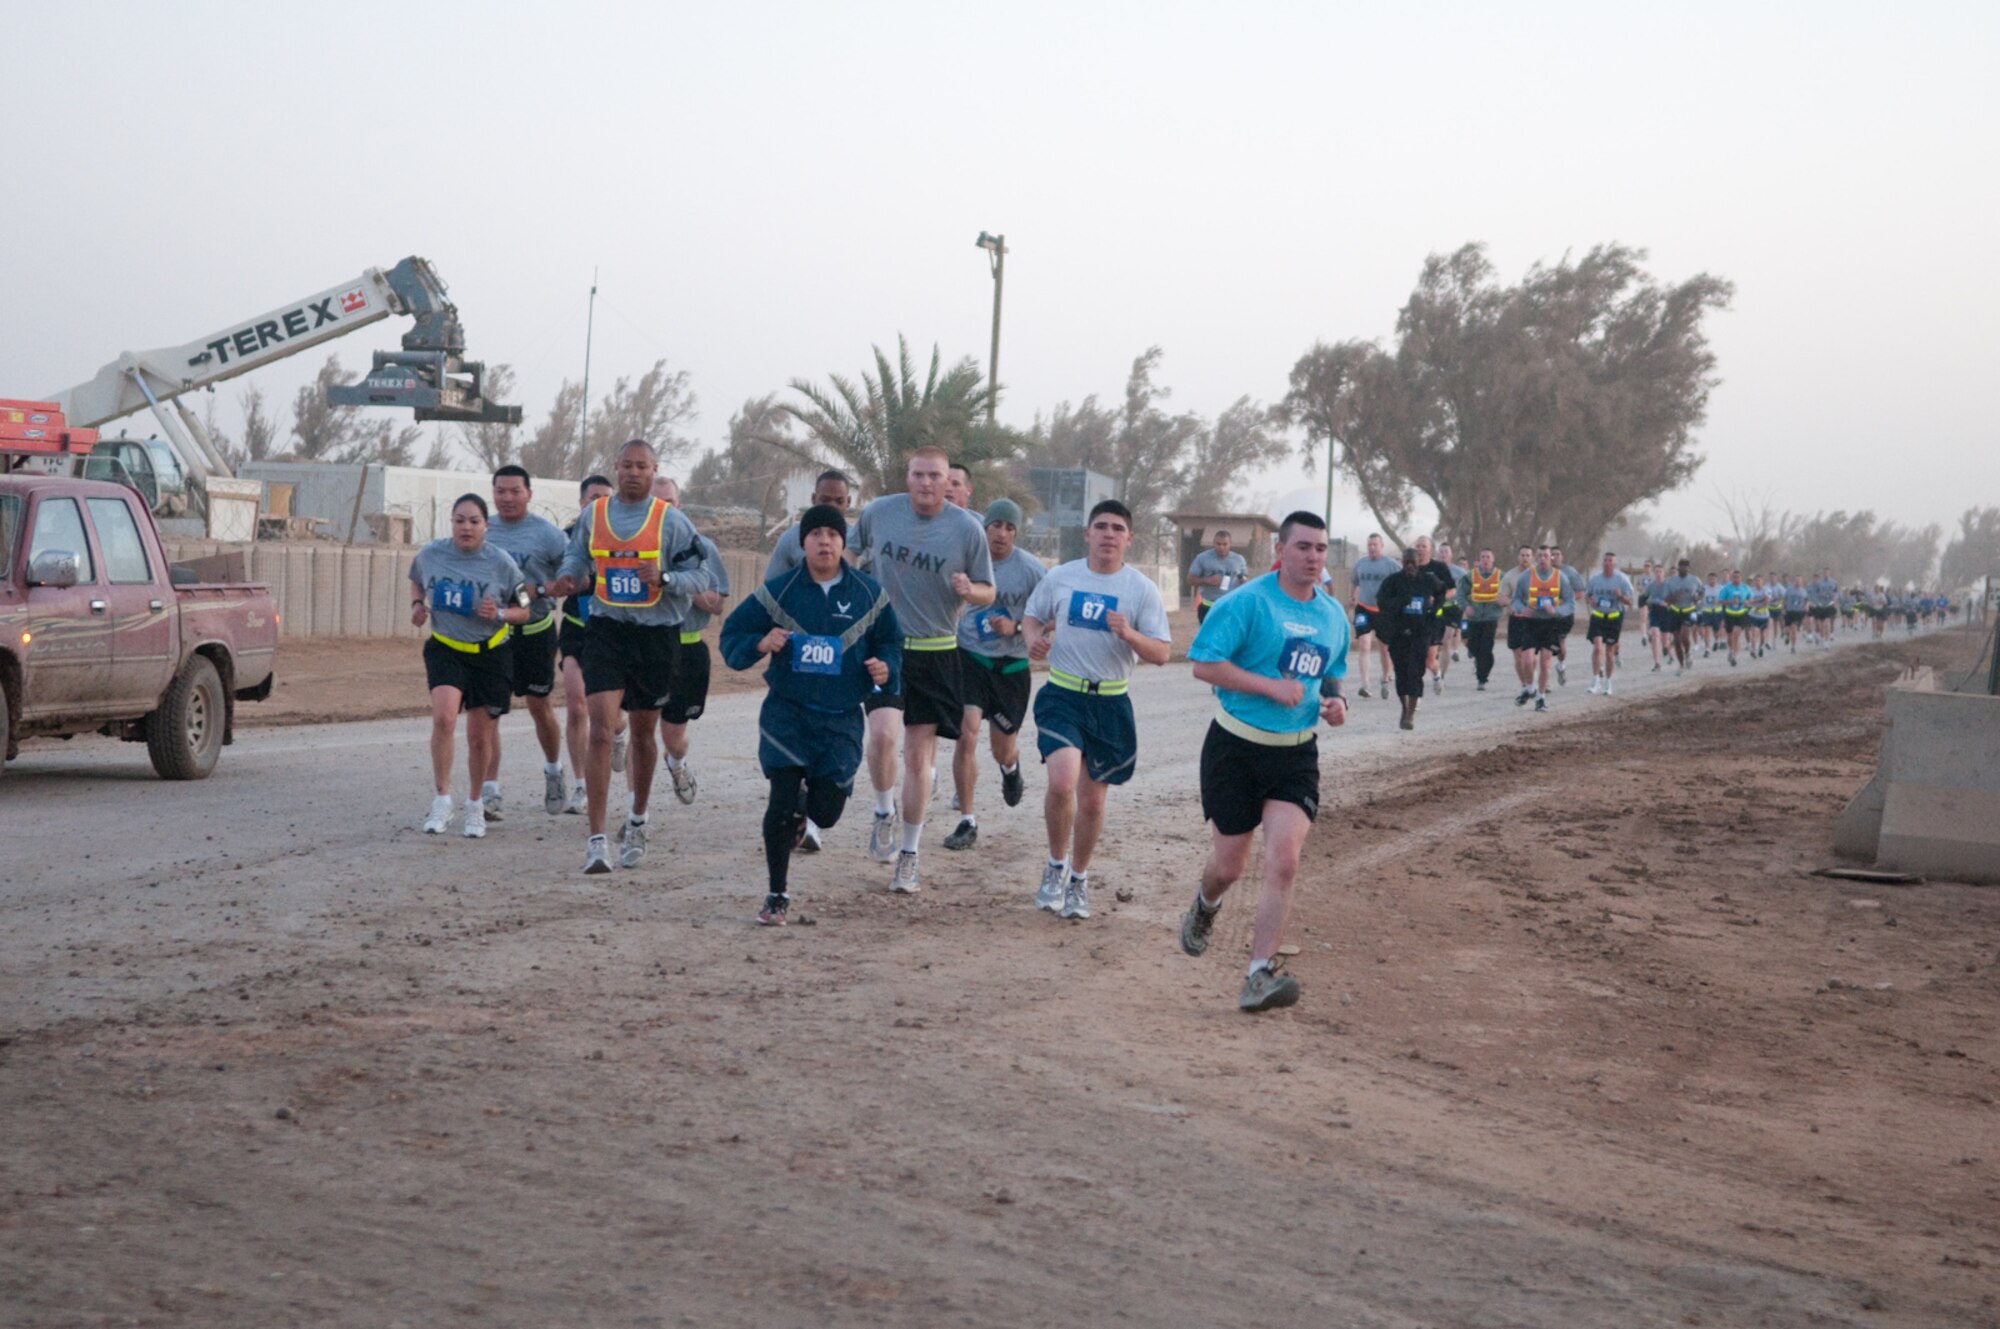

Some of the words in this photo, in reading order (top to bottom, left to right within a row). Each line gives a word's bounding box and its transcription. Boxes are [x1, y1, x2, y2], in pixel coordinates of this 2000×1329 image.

[207, 297, 339, 364] TEREX
[368, 378, 403, 389] TEREX
[881, 541, 946, 573] ARMY
[610, 576, 641, 594] 519
[444, 590, 462, 608] 14
[1082, 601, 1104, 620] 67
[801, 644, 834, 664] 200
[1289, 650, 1322, 676] 160
